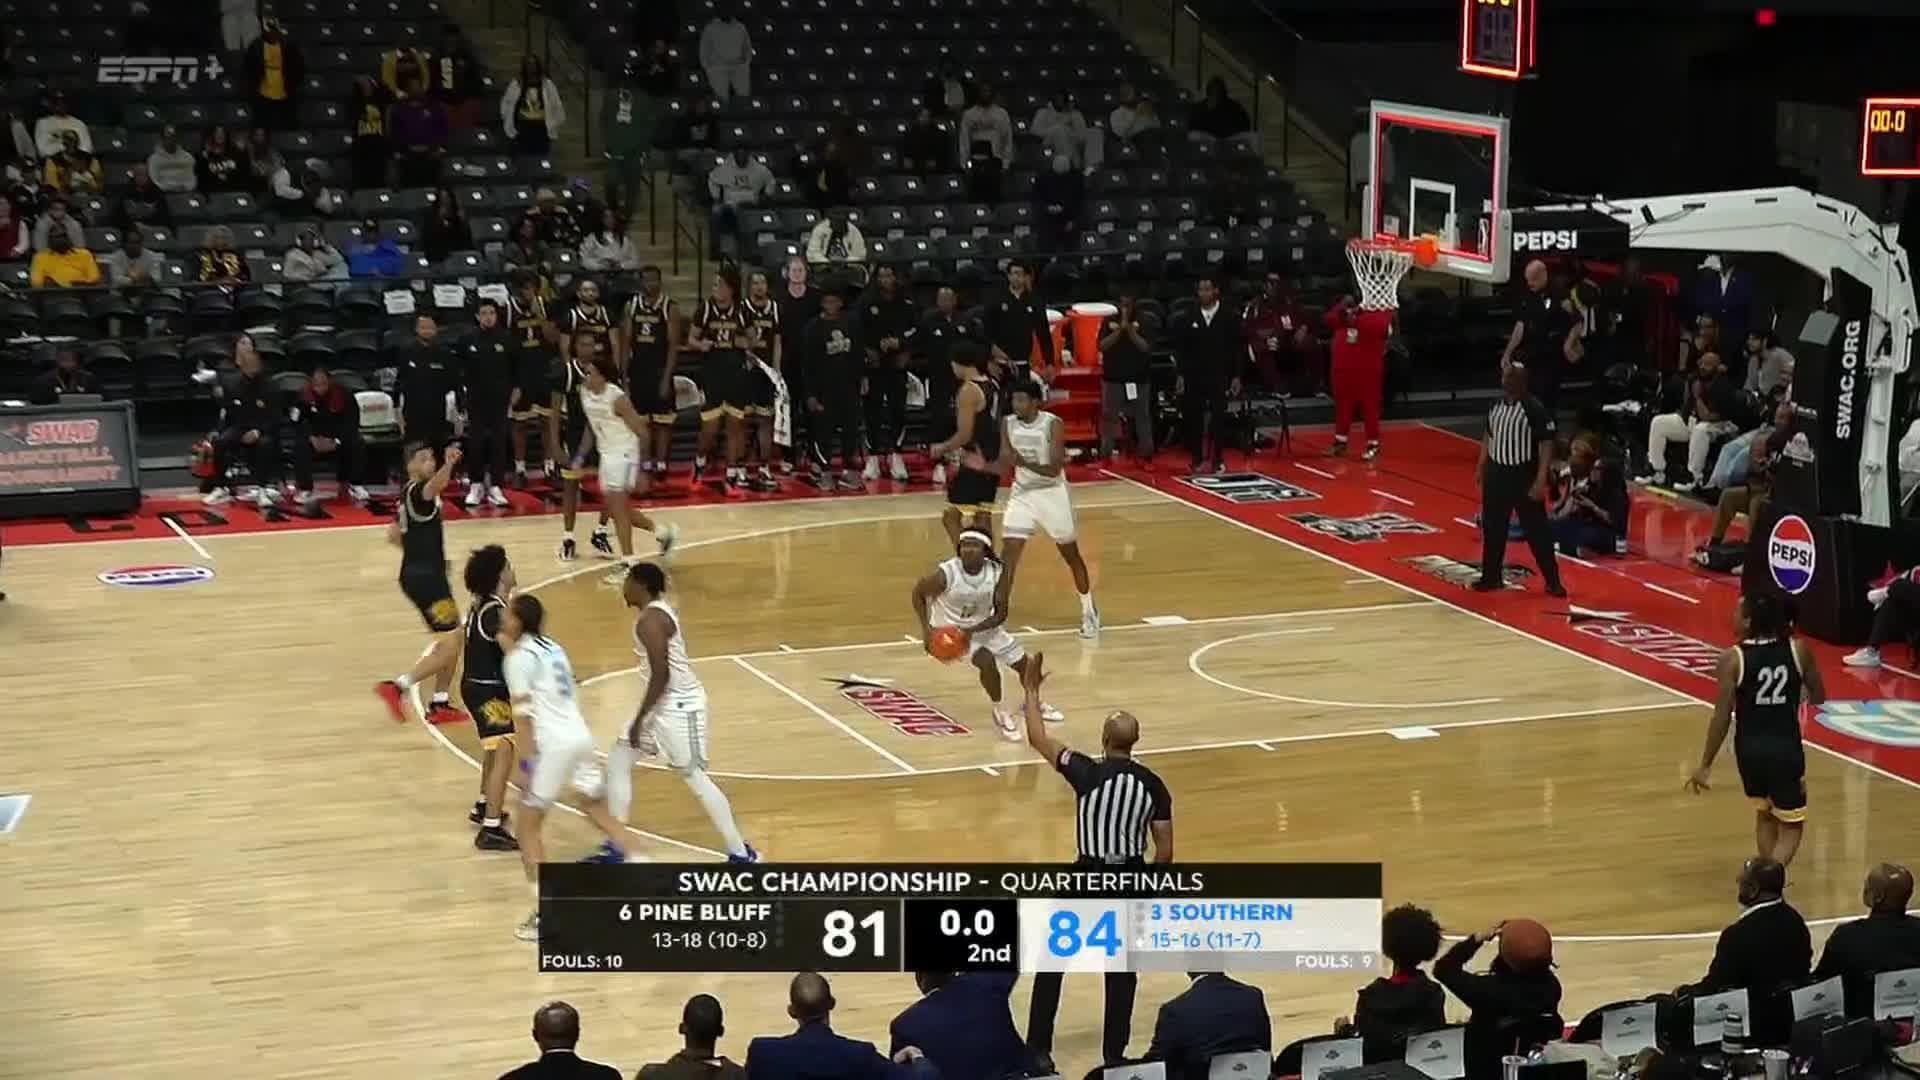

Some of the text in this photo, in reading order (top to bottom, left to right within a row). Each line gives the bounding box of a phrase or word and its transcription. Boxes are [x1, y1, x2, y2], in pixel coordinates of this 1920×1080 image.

[1870, 110, 1906, 132] 00.0
[1513, 230, 1577, 251] PEPSI
[1836, 320, 1860, 438] SWAC.ORG
[1772, 542, 1812, 568] PEPSI
[1755, 664, 1789, 705] 22
